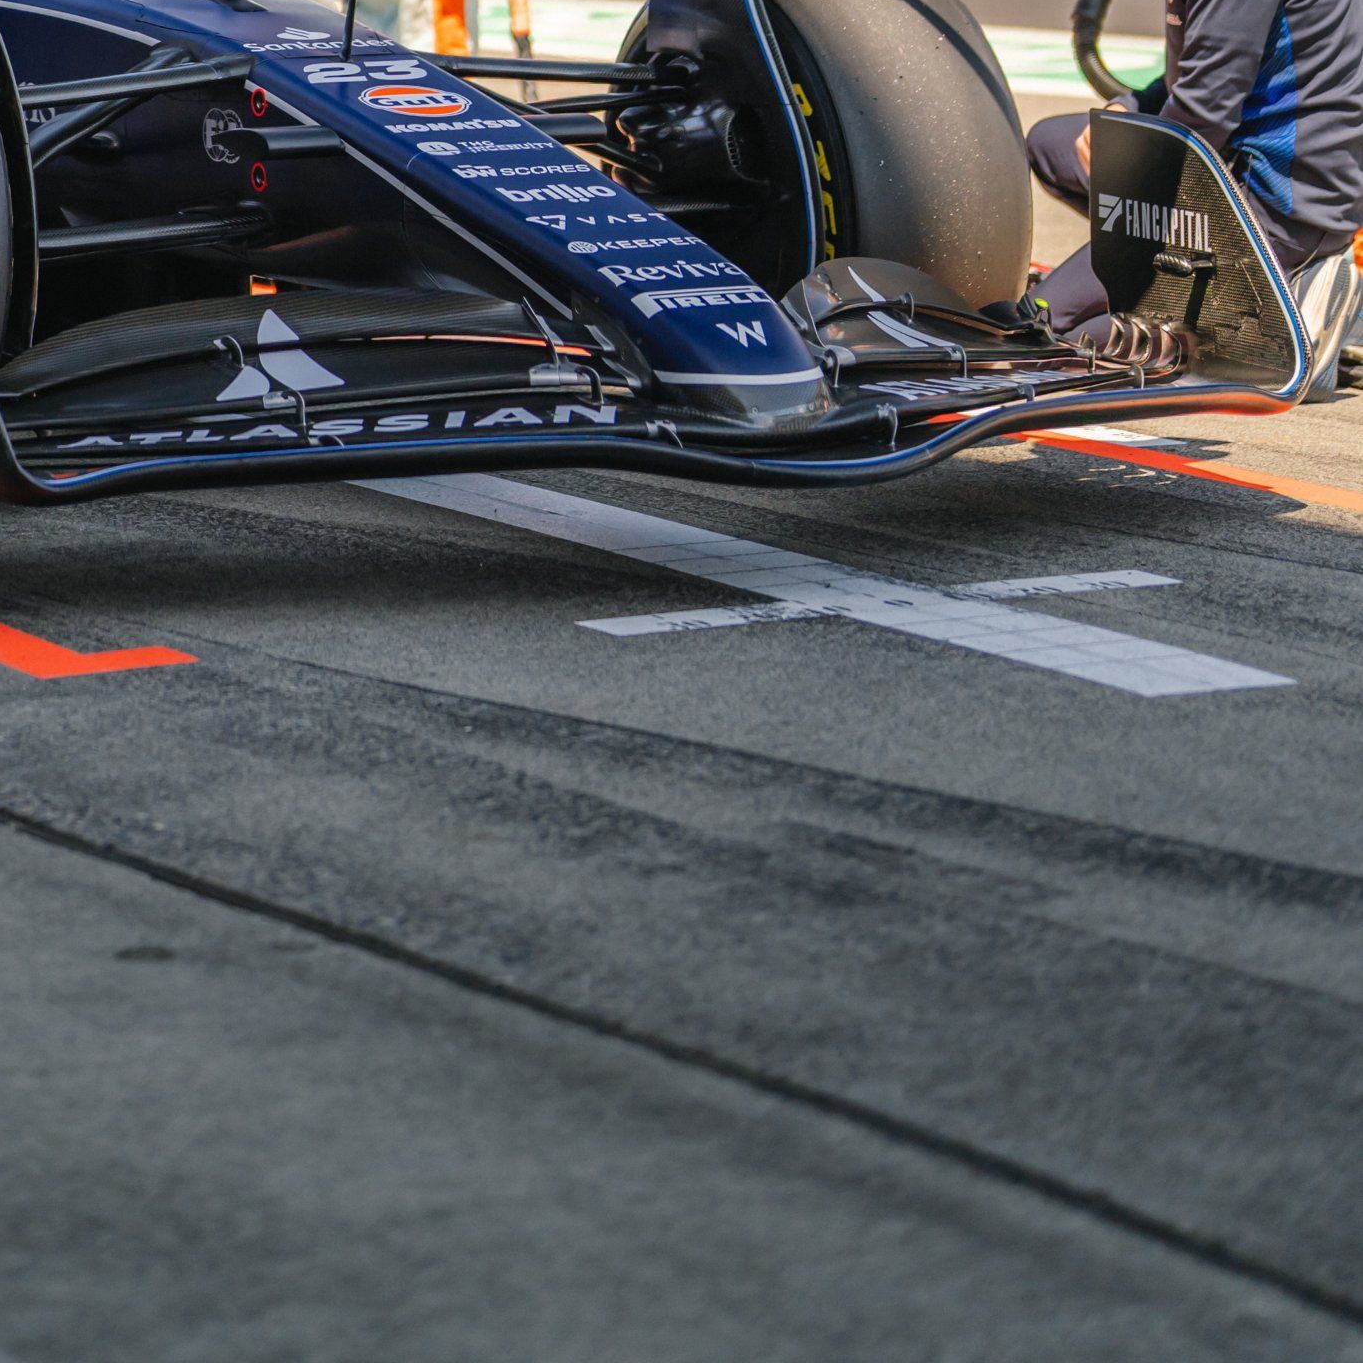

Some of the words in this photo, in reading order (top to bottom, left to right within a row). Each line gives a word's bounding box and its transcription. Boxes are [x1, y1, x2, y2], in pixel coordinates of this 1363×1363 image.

[243, 38, 396, 53] Santander
[303, 59, 428, 84] 23
[369, 93, 461, 107] Gulf
[384, 118, 523, 134] KOMATSU
[499, 163, 592, 177] SCORES
[1125, 198, 1213, 253] FANCAPITAL
[716, 320, 768, 348] W
[57, 404, 619, 450] ATLASSIAN
